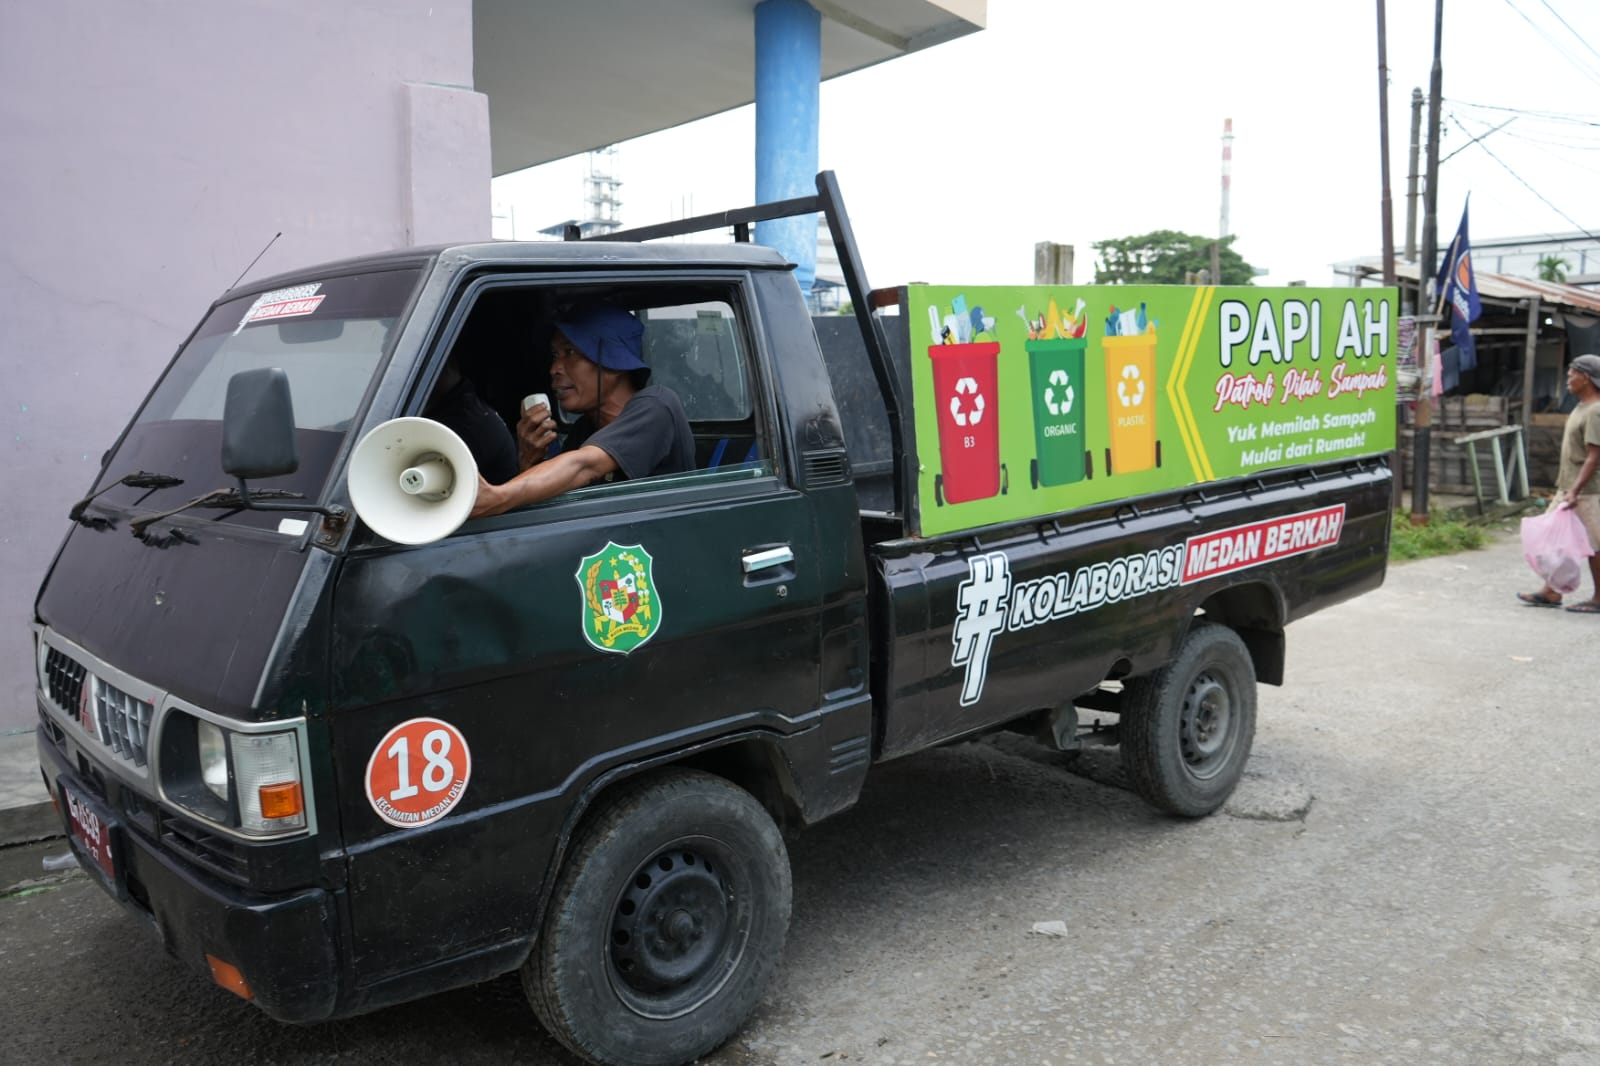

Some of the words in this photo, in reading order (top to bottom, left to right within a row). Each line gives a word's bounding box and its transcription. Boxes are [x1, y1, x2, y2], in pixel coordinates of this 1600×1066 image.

[1219, 299, 1321, 367] PAPI
[1335, 299, 1389, 359] AH
[1213, 372, 1274, 412] Patroli
[1280, 367, 1322, 401] Pilah
[1328, 361, 1387, 399] Sampah
[1044, 422, 1077, 438] ORGANIC
[1118, 415, 1145, 427] PLASTIC
[1227, 424, 1256, 443] Yuk
[1261, 414, 1320, 438] Memilah
[1323, 408, 1376, 429] Sampah
[963, 436, 975, 448] B3
[1240, 443, 1282, 467] Mulai
[1286, 439, 1312, 459] dari
[1316, 432, 1366, 454] Rumah!
[1187, 529, 1262, 577] MEDAN
[1264, 508, 1341, 556] BERKAH
[388, 729, 454, 800] 18
[375, 796, 420, 822] KECAMATAN
[421, 797, 452, 820] MEDAN
[447, 779, 465, 799] DELI
